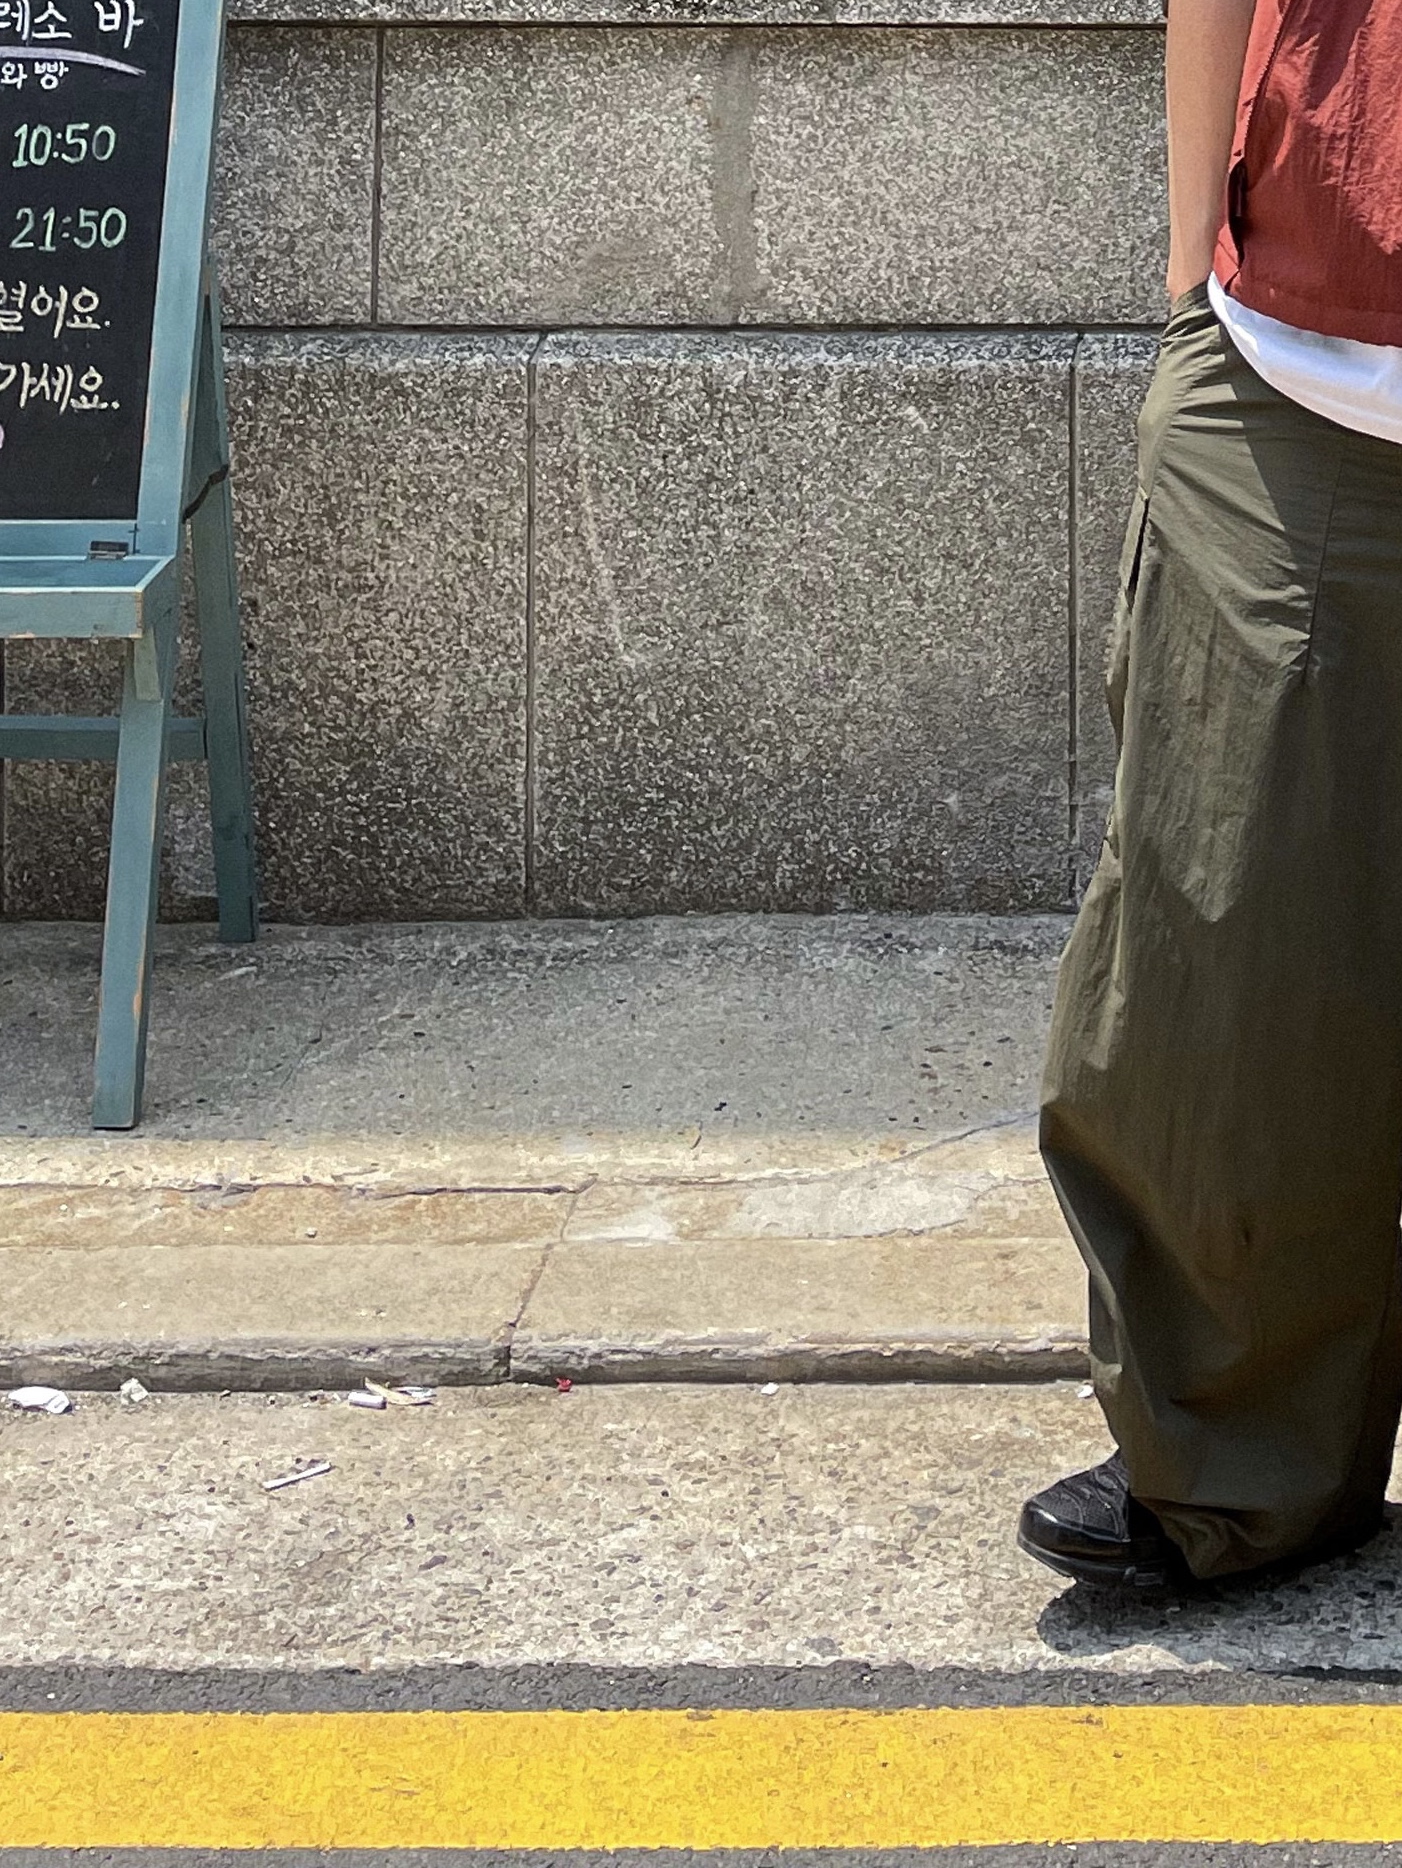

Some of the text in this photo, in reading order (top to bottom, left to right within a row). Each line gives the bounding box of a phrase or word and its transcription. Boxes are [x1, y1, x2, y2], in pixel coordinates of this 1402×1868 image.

[34, 61, 70, 90] 빵
[12, 123, 116, 168] 10:50
[9, 206, 127, 252] 21:50
